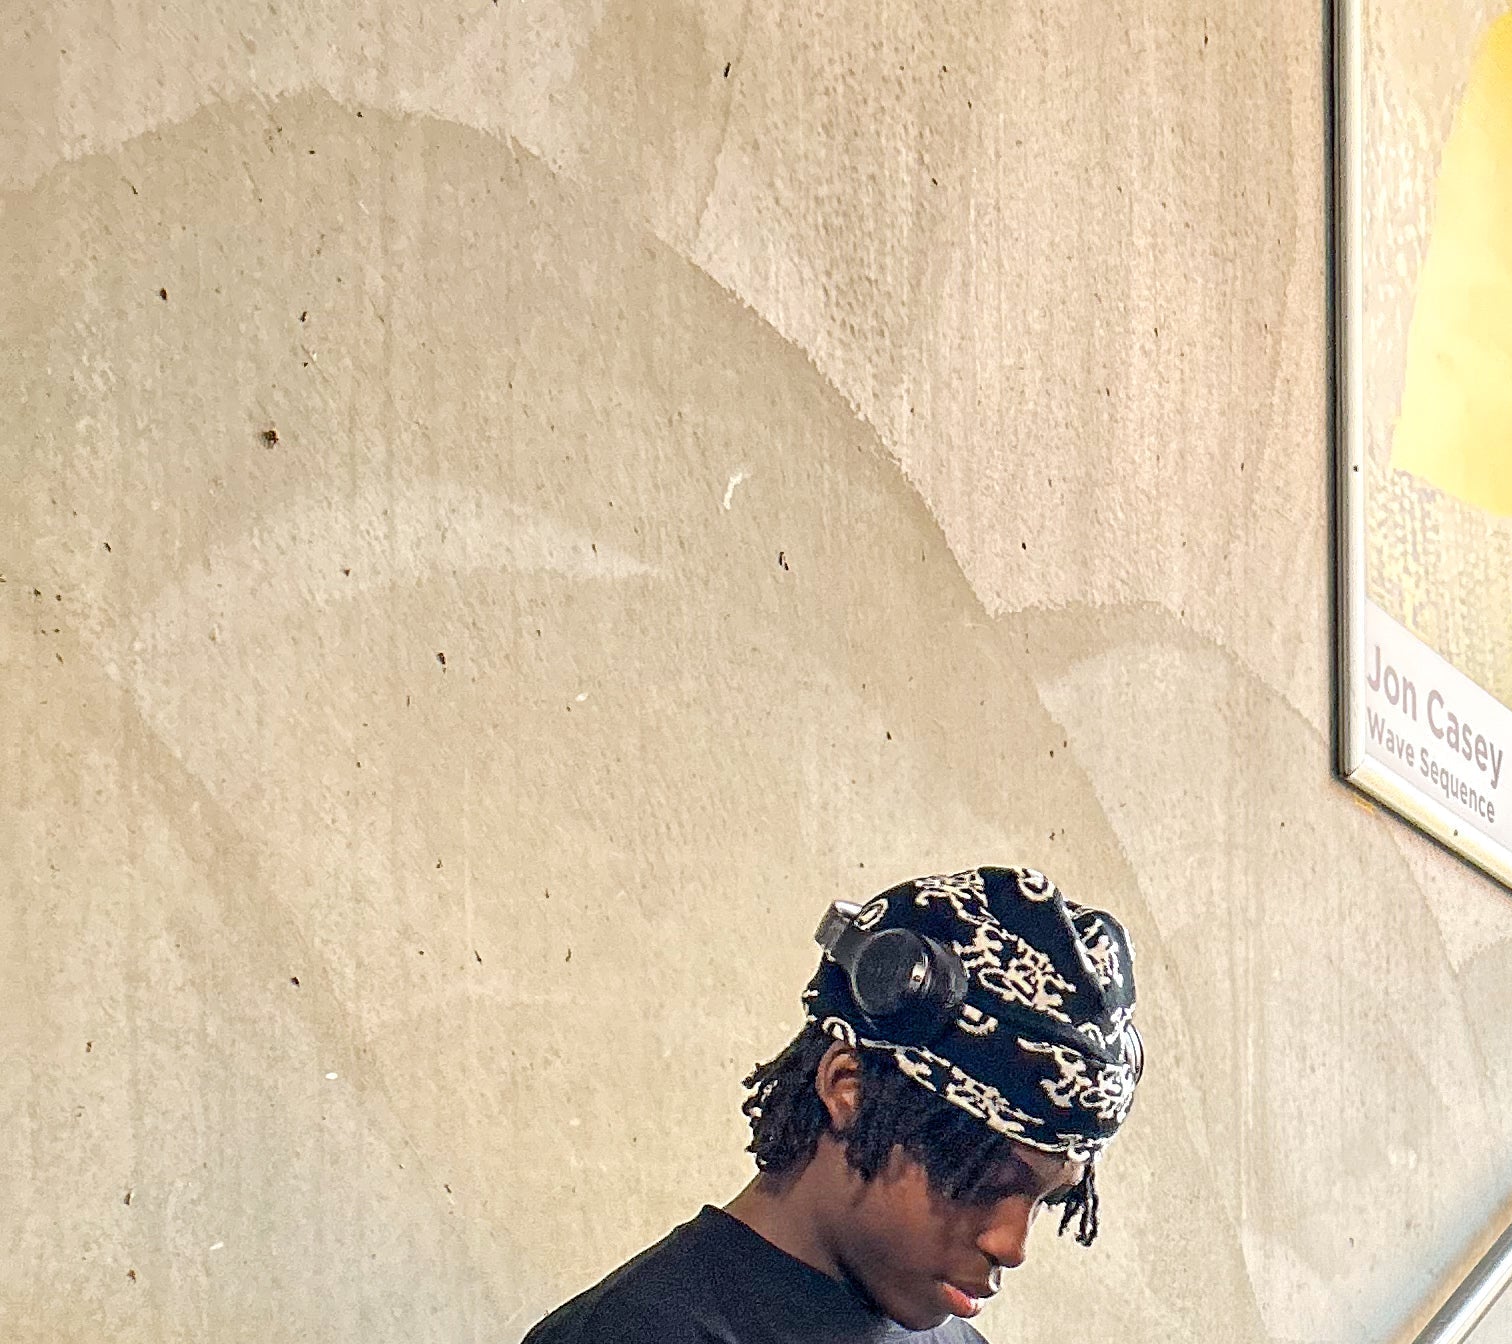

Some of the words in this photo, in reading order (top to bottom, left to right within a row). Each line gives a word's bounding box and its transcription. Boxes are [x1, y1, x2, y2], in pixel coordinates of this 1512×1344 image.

[1367, 645, 1417, 721] Jon
[1427, 689, 1503, 790] Casey
[1367, 706, 1415, 767] Wave
[1420, 747, 1495, 823] Sequence
